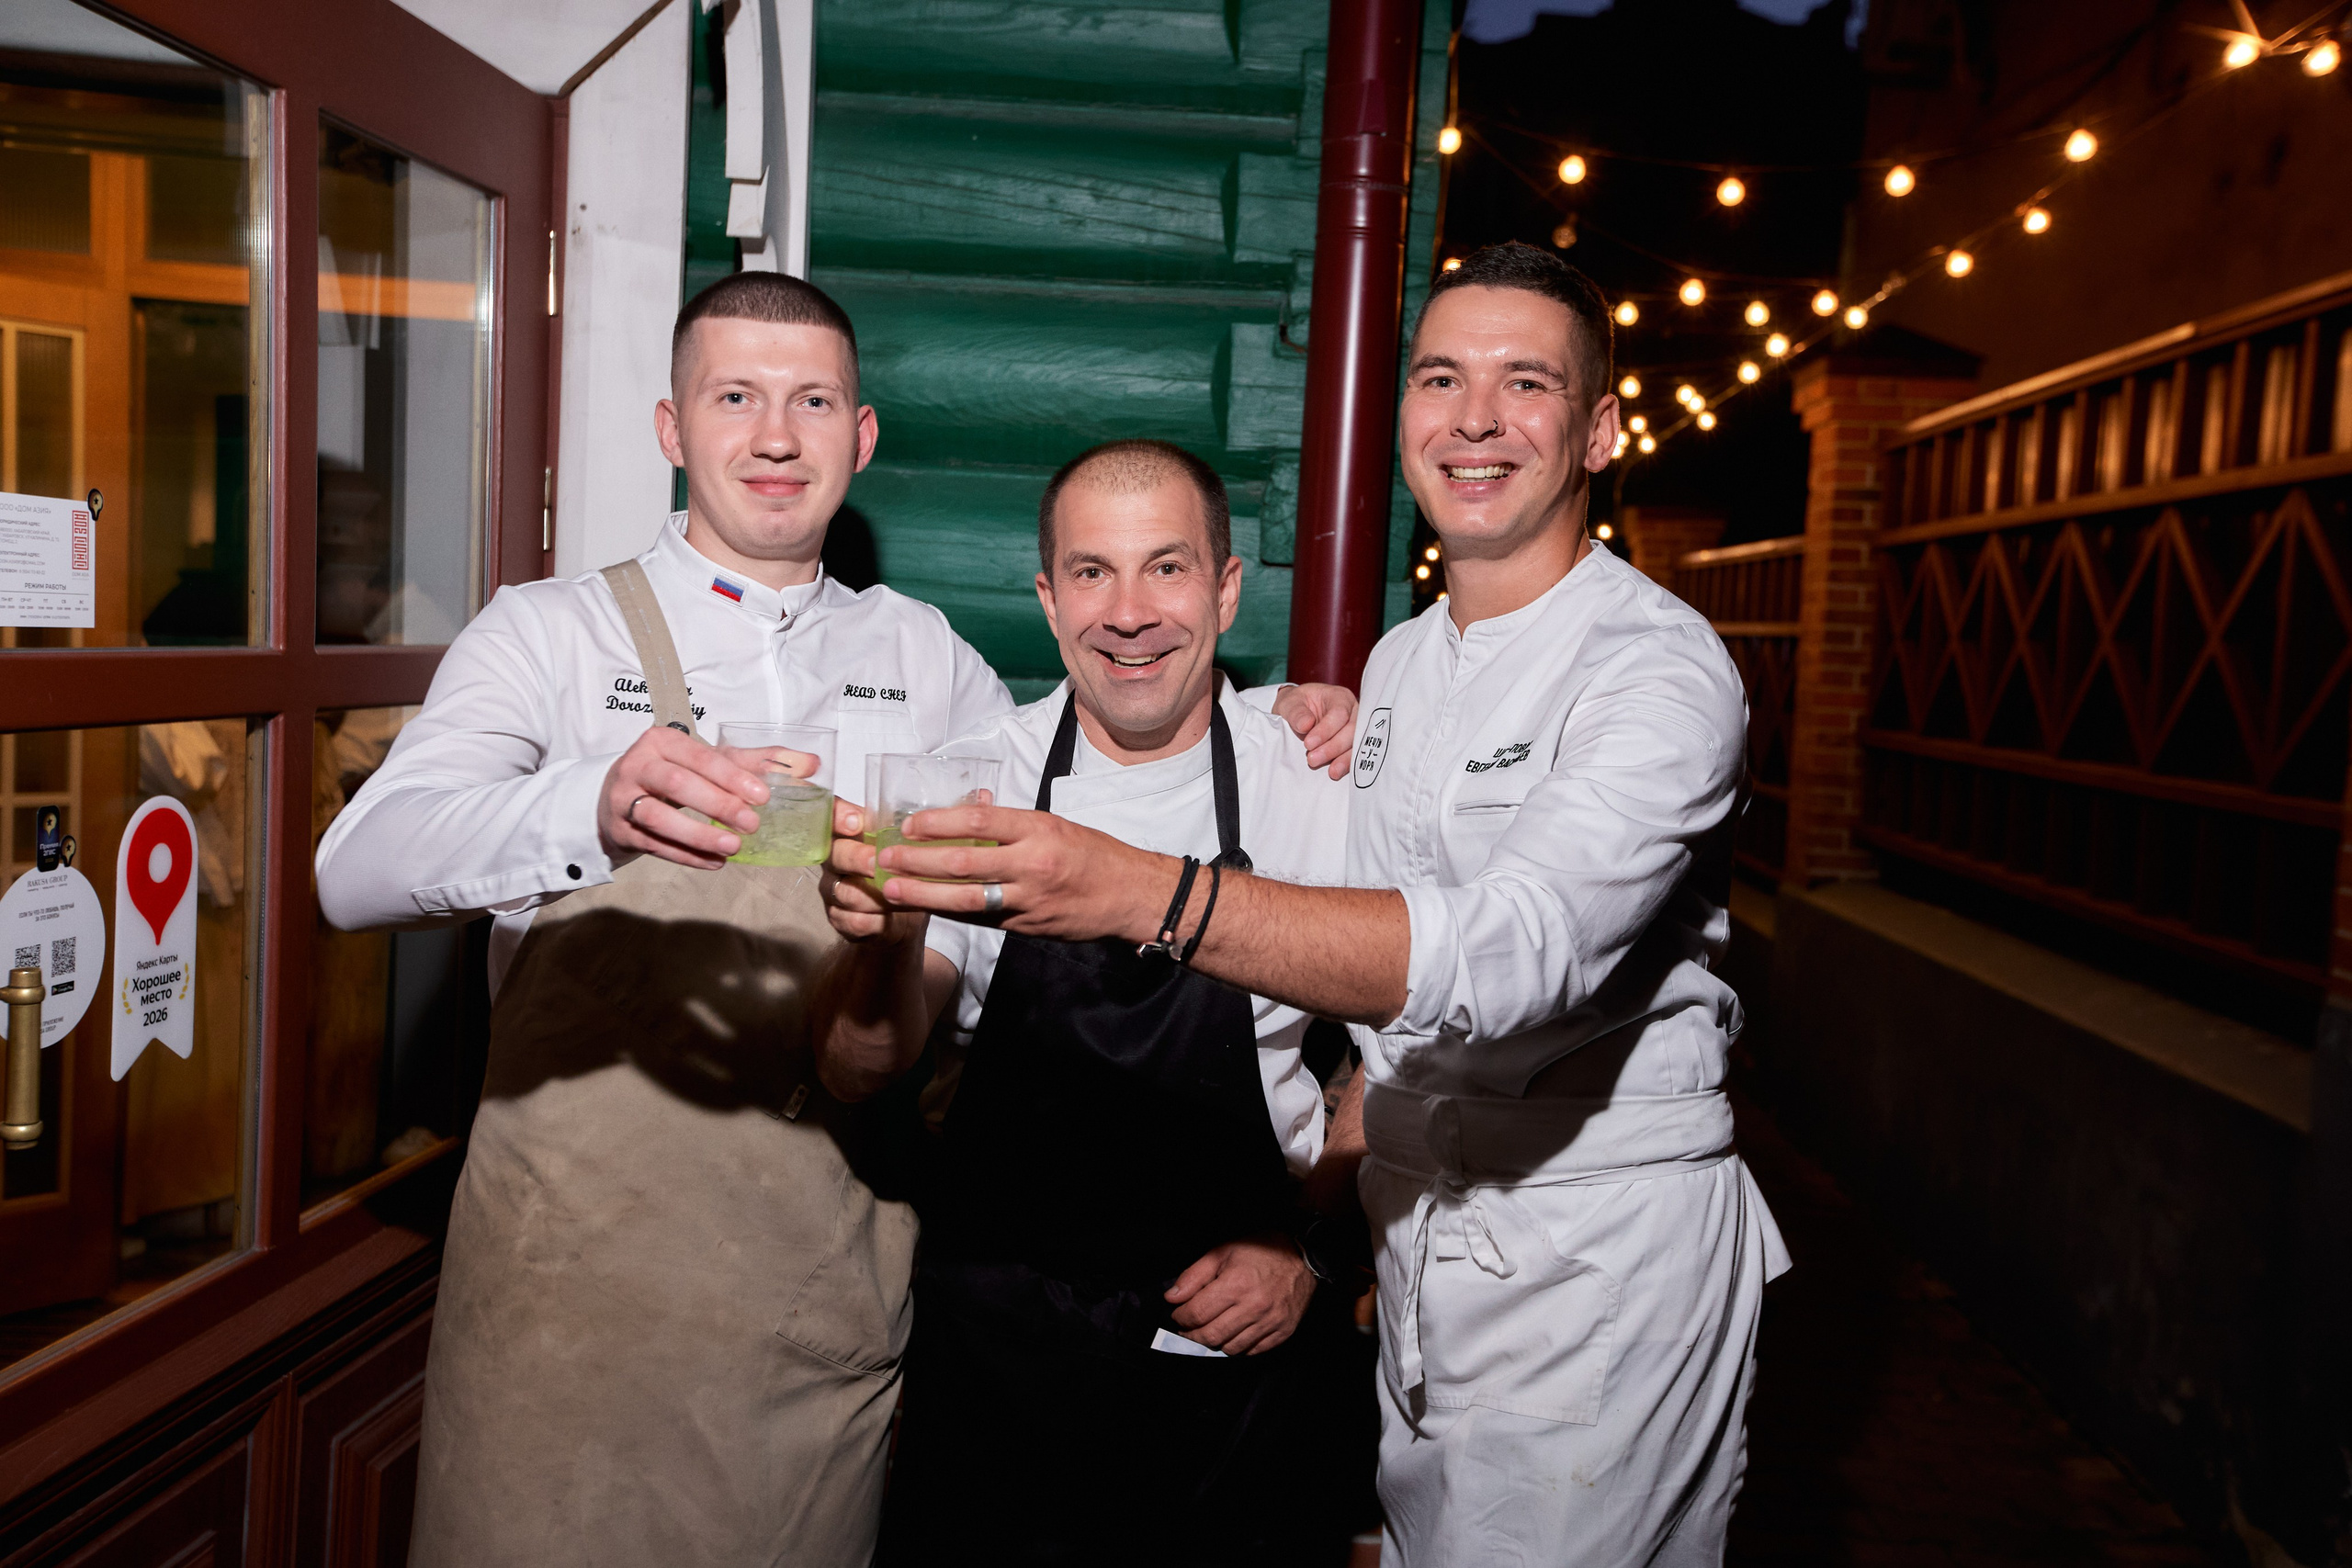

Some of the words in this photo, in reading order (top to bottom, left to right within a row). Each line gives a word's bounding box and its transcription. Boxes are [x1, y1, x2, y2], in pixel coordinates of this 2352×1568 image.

[843, 683, 876, 699] HEAD
[880, 688, 907, 702] CHEF
[136, 959, 158, 971] Яндекс
[159, 954, 178, 965] Карты
[132, 971, 181, 992] Хорошее
[141, 988, 172, 1006] место
[142, 1007, 168, 1027] 2026
